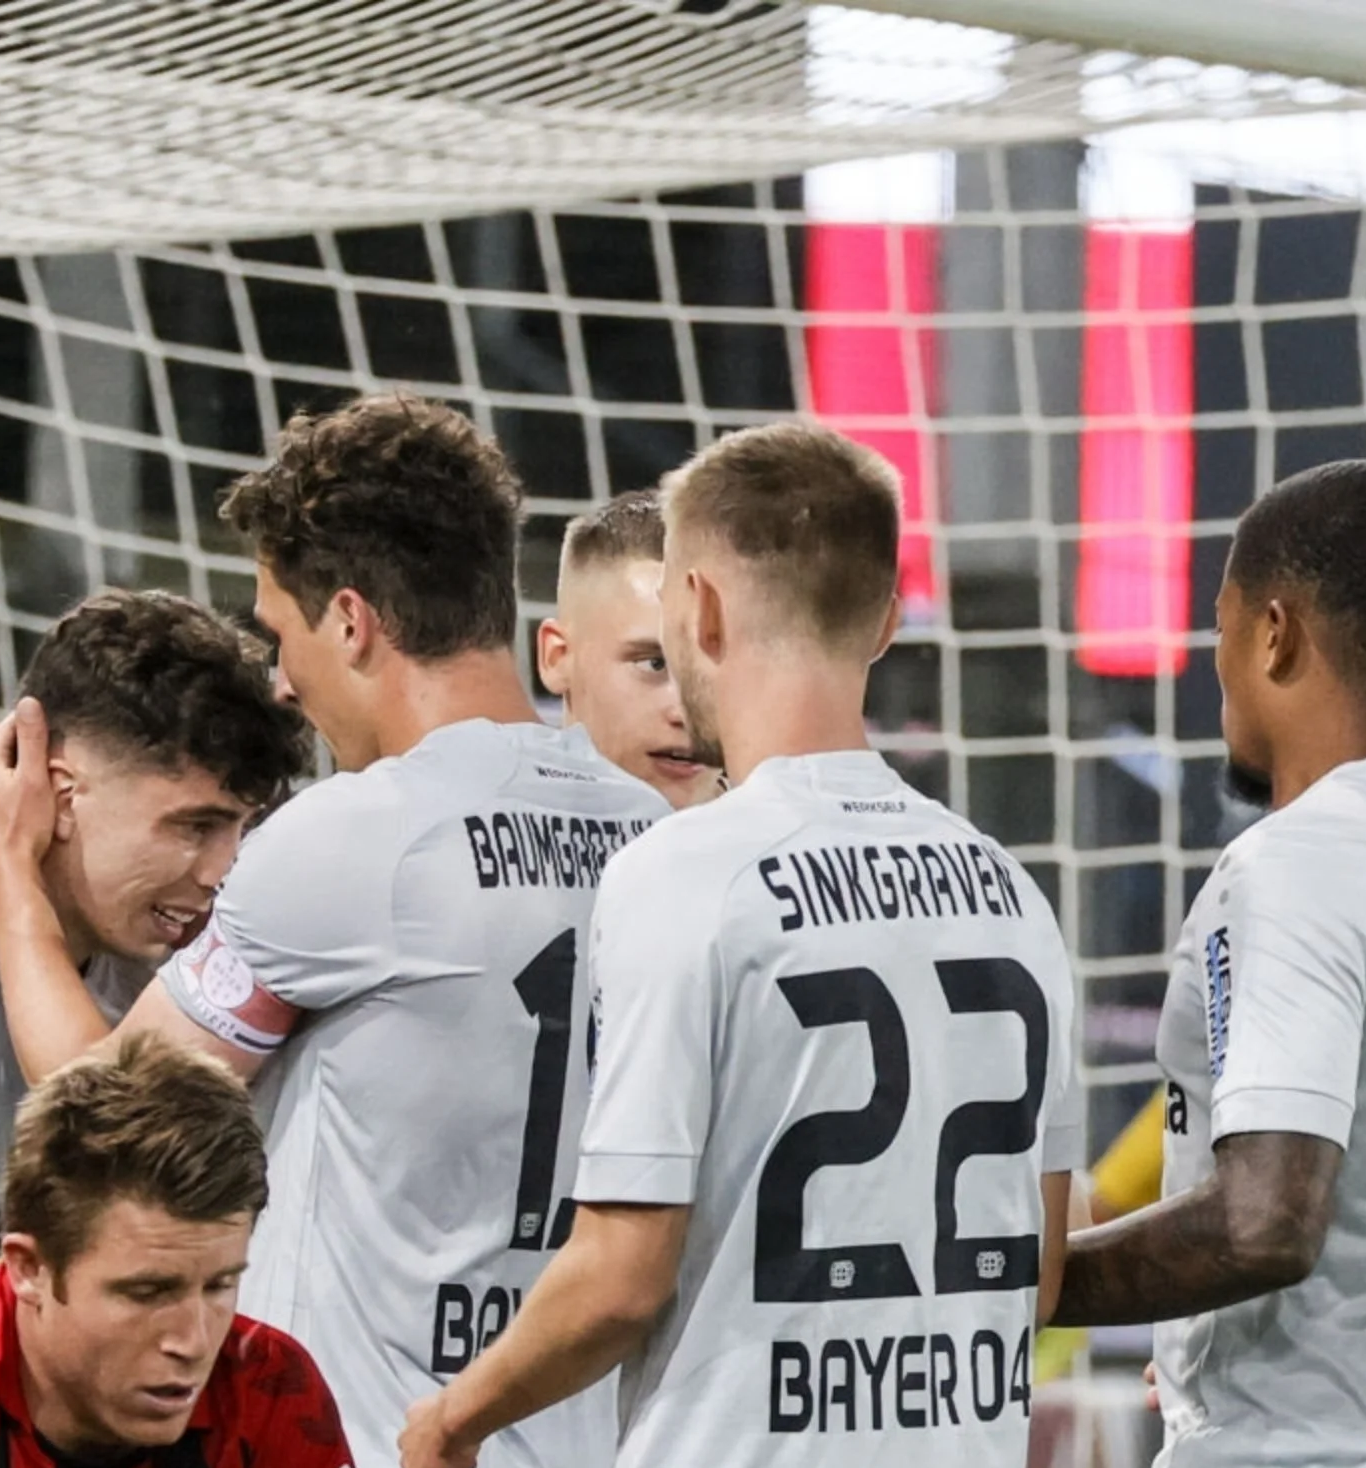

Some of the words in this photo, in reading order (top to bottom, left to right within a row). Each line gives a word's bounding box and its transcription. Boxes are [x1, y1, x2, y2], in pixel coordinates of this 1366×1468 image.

[758, 844, 1023, 932] SINKGRAVEN
[753, 956, 1048, 1302] 22
[769, 1332, 961, 1433] BAYER
